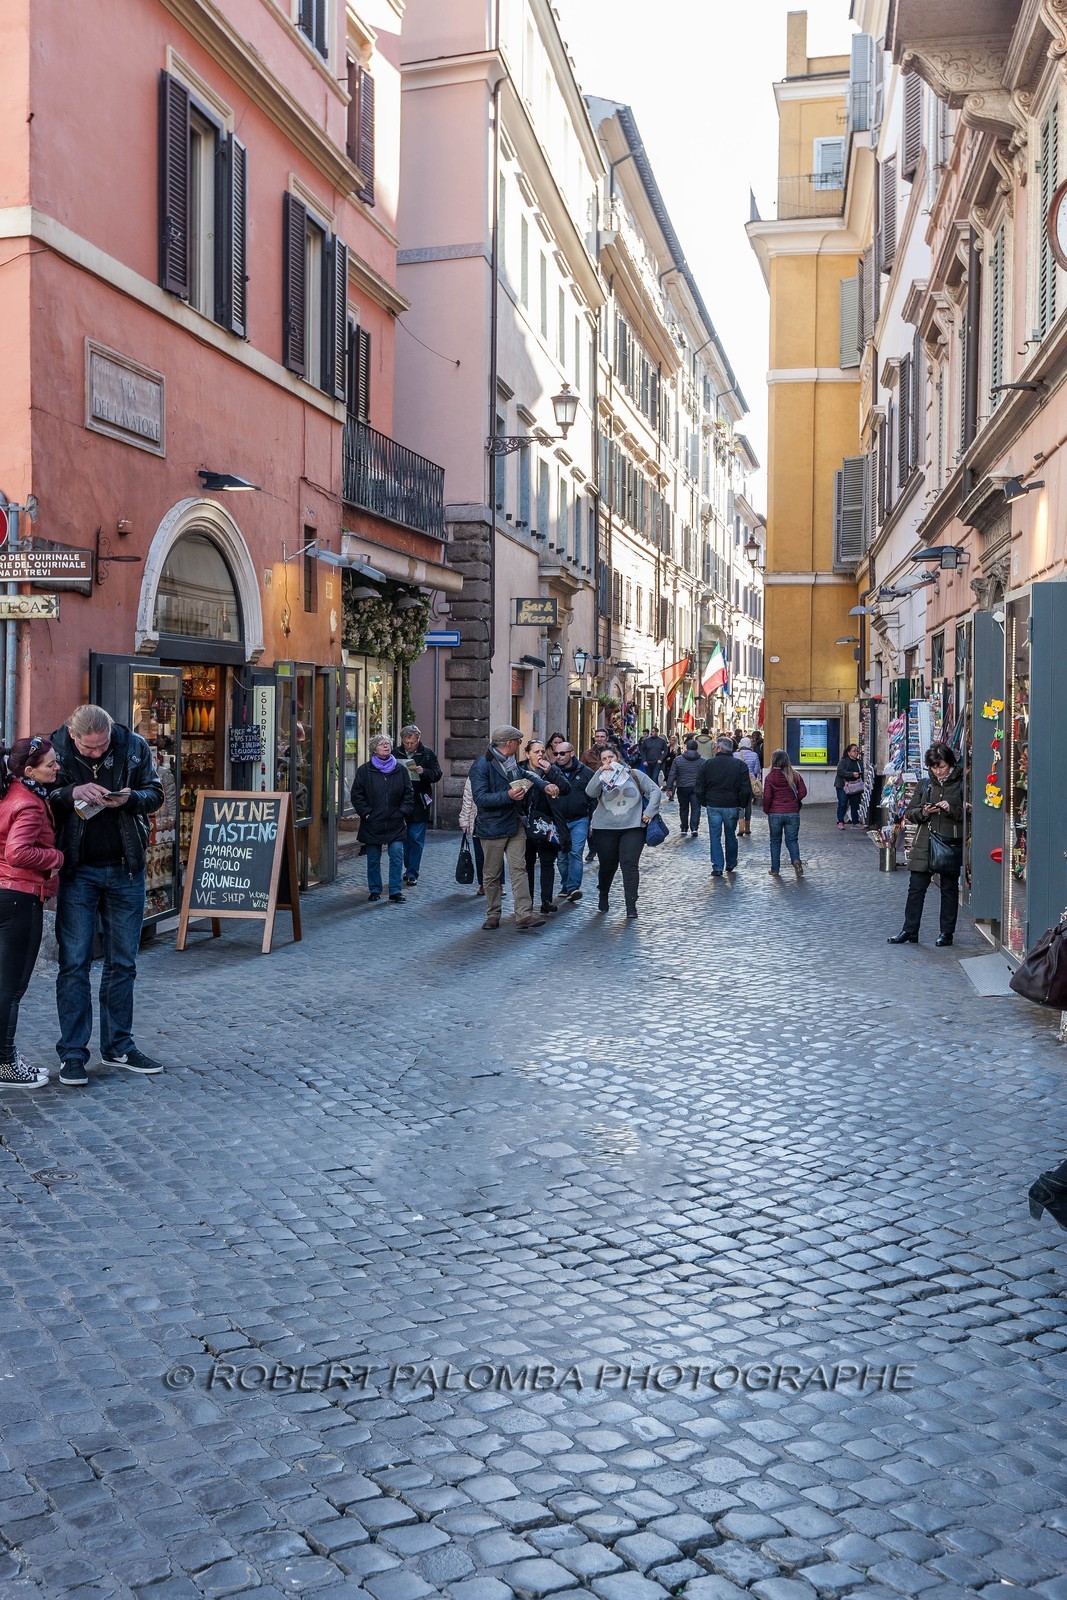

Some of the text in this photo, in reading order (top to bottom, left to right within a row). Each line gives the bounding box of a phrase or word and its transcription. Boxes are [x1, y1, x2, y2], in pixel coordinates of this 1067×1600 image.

[121, 376, 137, 401] VIA
[94, 397, 160, 440] DEL LAVATORE
[9, 553, 26, 561] DEL
[28, 553, 80, 561] QUIRINALE
[15, 561, 32, 569] DEL
[34, 561, 87, 569] QUIRINALE
[12, 569, 22, 577] DI
[24, 568, 51, 577] TREVI
[522, 600, 554, 612] Bar &
[520, 611, 555, 624] Pizza
[213, 801, 275, 823] WINE
[205, 822, 278, 843] TASTING
[195, 889, 216, 905] WE
[222, 892, 246, 904] SHIP
